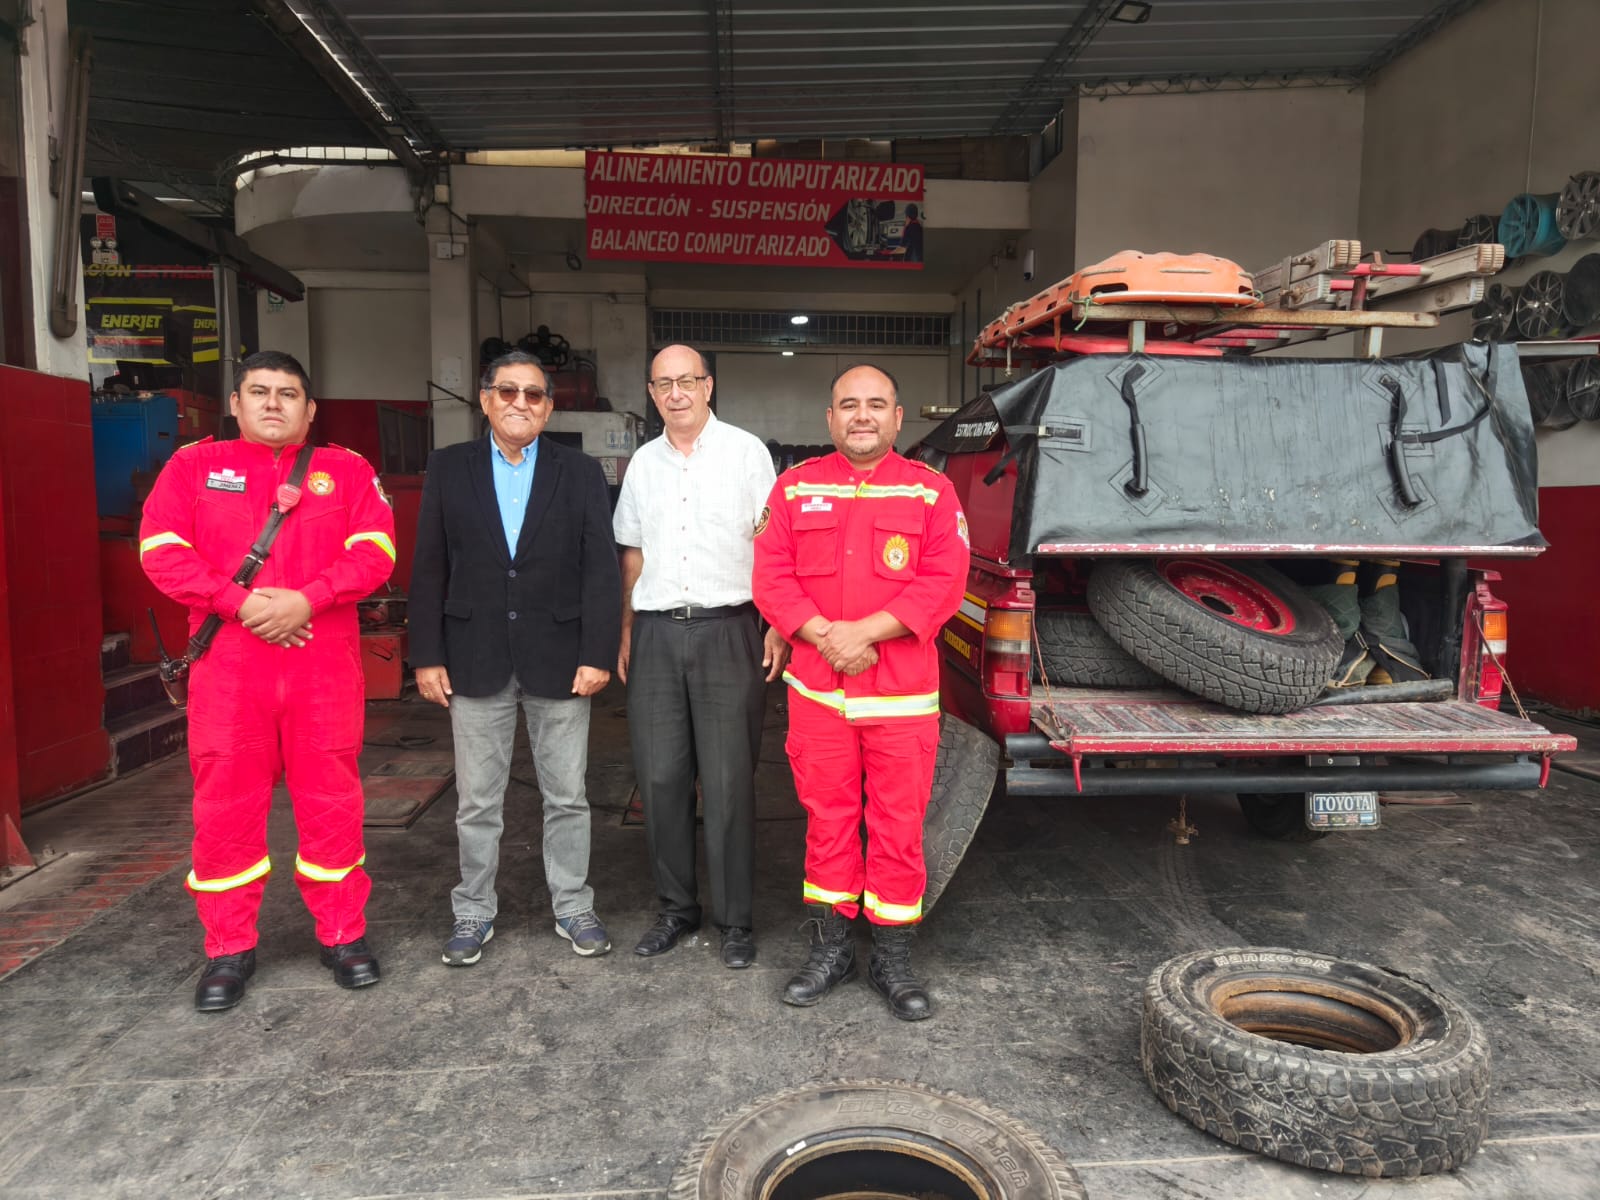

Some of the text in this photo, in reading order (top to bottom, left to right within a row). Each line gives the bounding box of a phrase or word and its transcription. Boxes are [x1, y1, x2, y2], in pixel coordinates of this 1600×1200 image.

[591, 155, 921, 194] ALINEAMIENTO COMPUTARIZADO
[588, 194, 690, 217] DIRECCIÓN
[710, 197, 831, 222] SUSPENSIÓN
[591, 229, 831, 257] BALANCEO COMPUTARIZADO
[101, 314, 162, 331] ENERJET
[1315, 796, 1371, 811] TOYOTA
